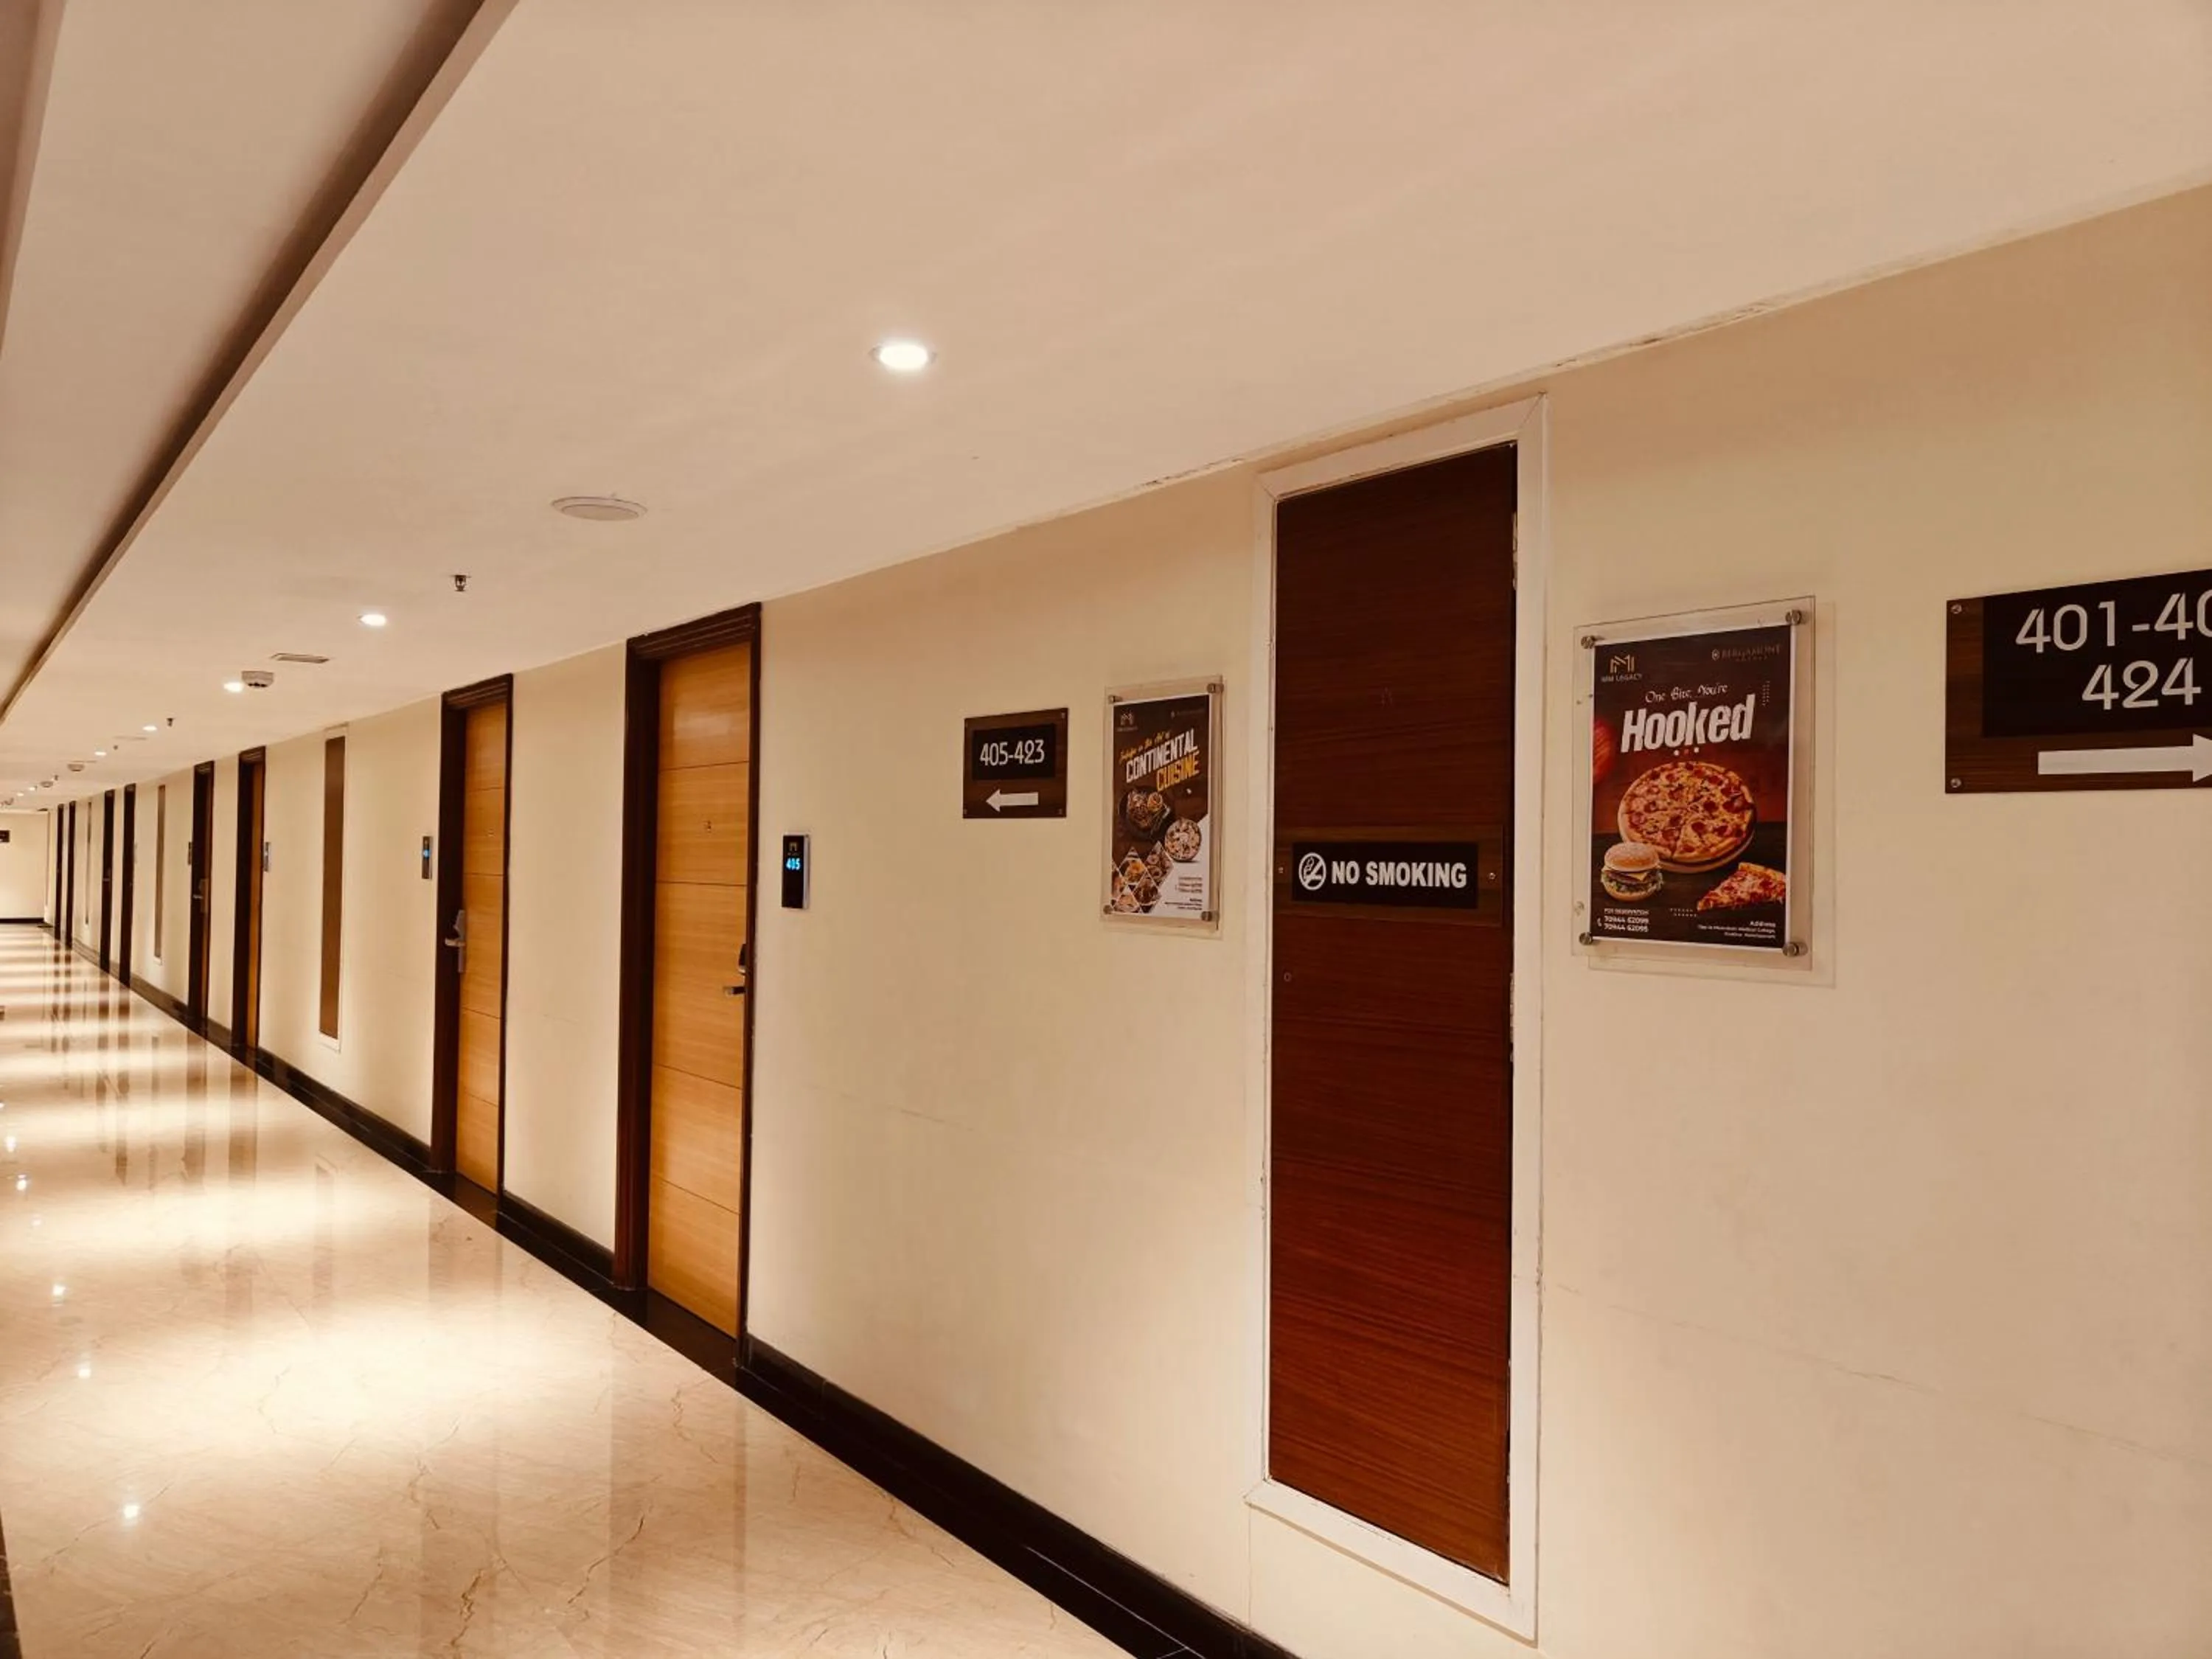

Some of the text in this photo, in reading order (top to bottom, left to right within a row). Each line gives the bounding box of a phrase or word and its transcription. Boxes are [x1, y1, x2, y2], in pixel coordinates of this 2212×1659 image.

[1645, 690, 1666, 703] One
[2081, 657, 2202, 710] 424
[1621, 693, 1756, 753] Hooked
[979, 739, 1045, 766] 405-423
[1126, 728, 1197, 783] CONTINENTAL
[1156, 750, 1200, 791] CUISINE
[1331, 860, 1467, 888] NO SMOKING
